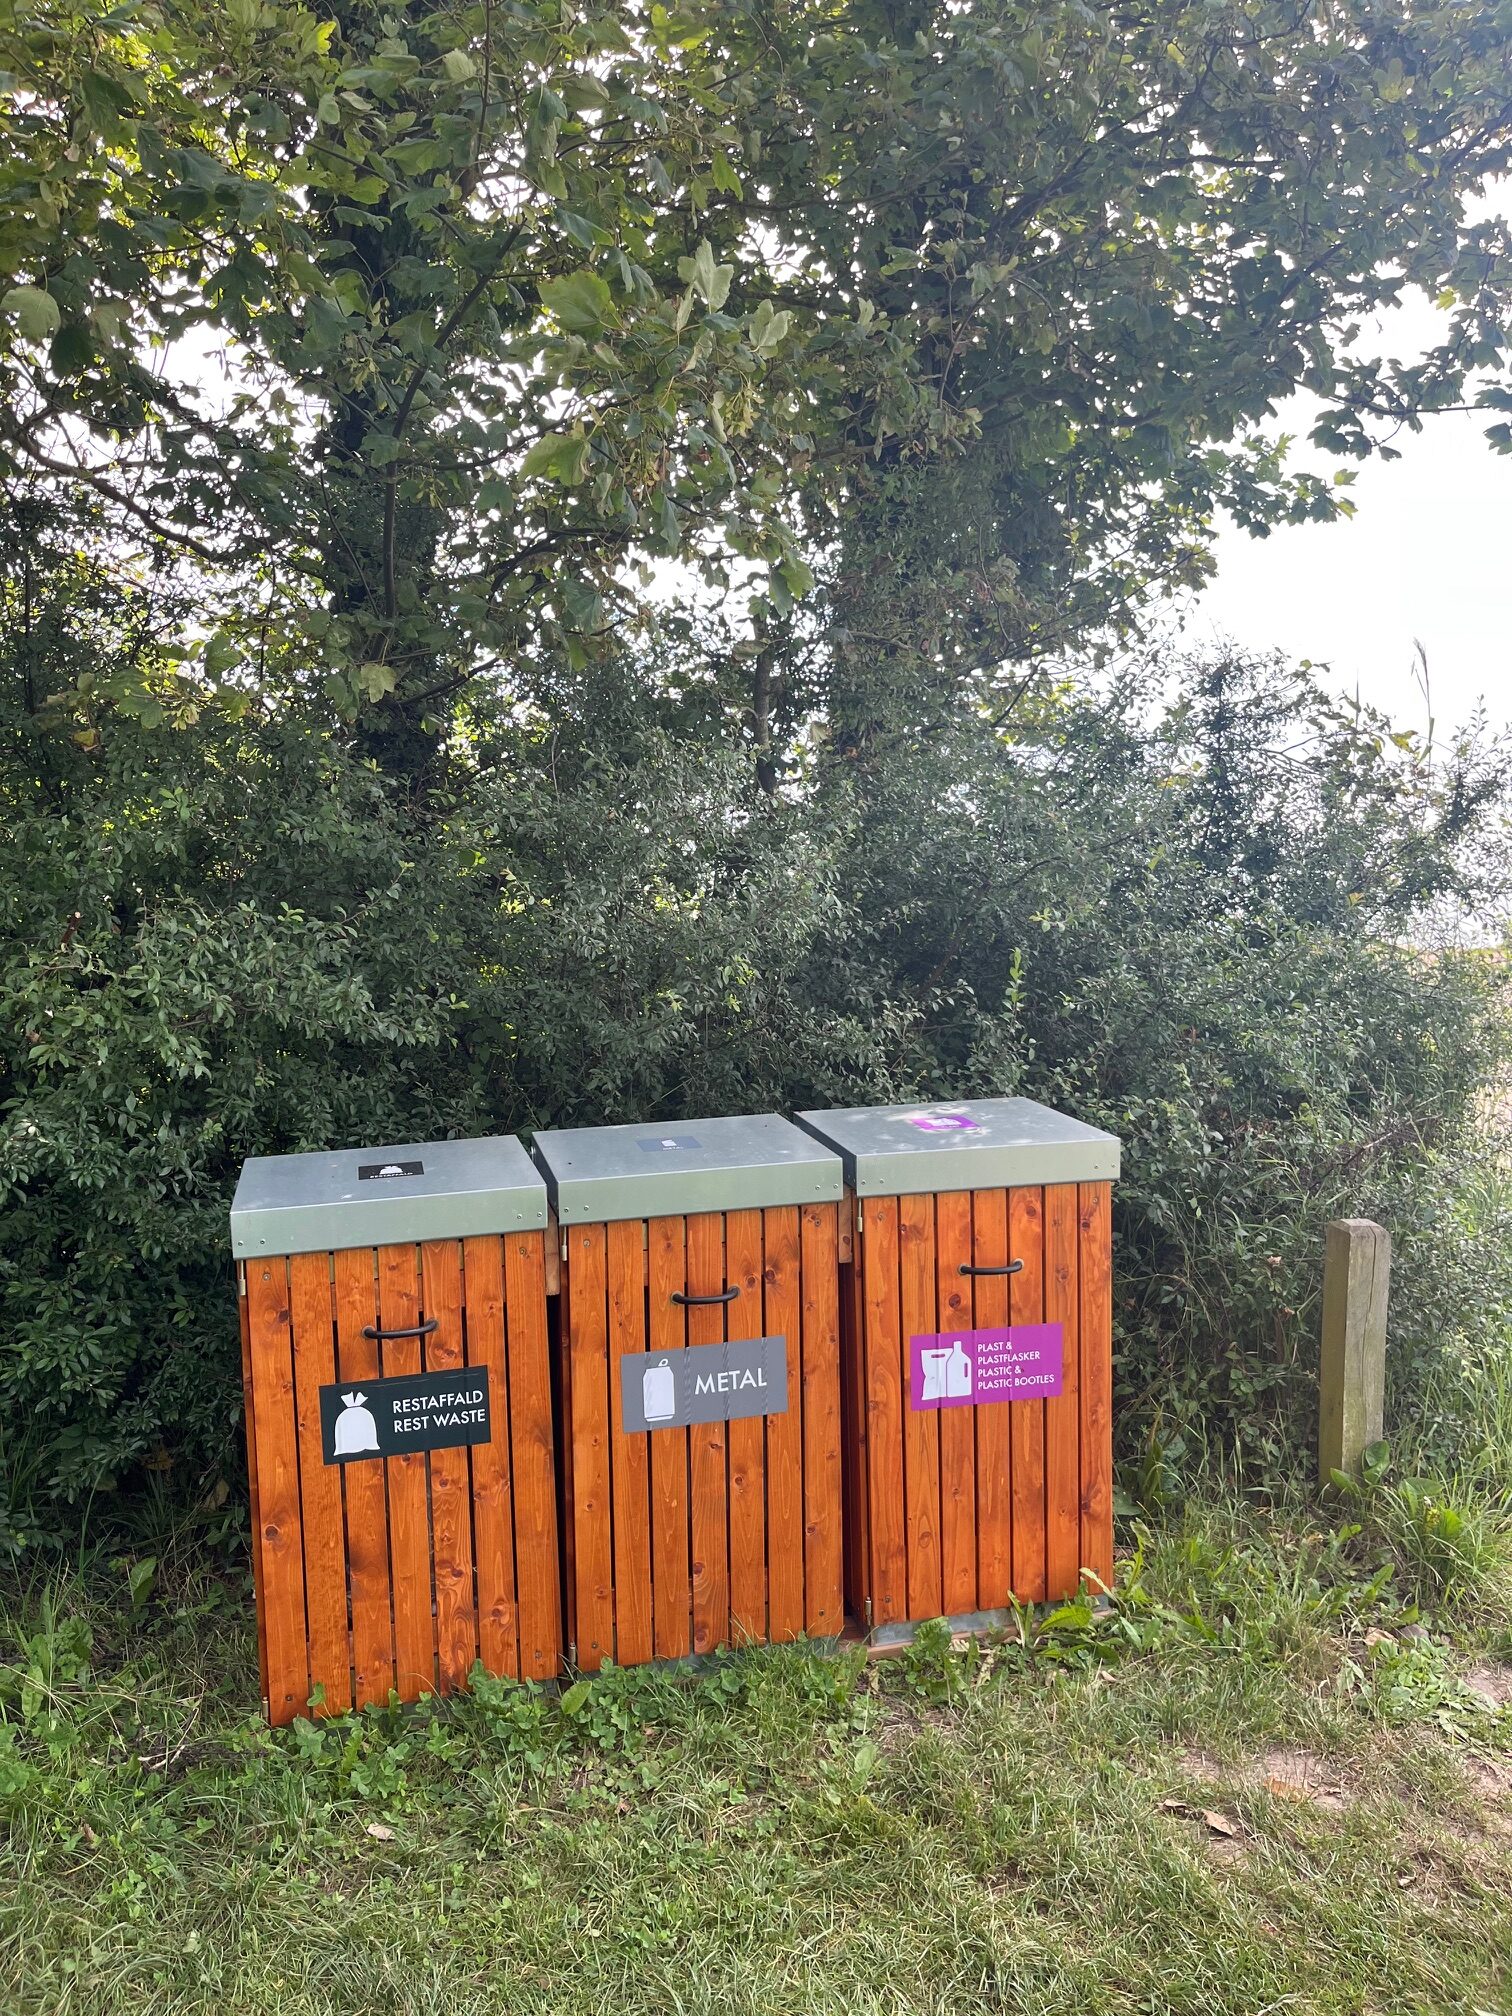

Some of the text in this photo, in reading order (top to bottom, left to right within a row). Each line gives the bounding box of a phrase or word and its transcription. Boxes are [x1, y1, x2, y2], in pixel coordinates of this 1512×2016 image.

[977, 1341, 1013, 1353] PLAST &
[977, 1351, 1041, 1365] PLASTFLASKER
[977, 1365, 1022, 1378] PLASTIC &
[694, 1367, 767, 1395] METAL
[977, 1374, 1055, 1390] PLASTIC BOOTLES
[393, 1390, 483, 1414] RESTAFFALD
[394, 1409, 486, 1433] REST WASTE
